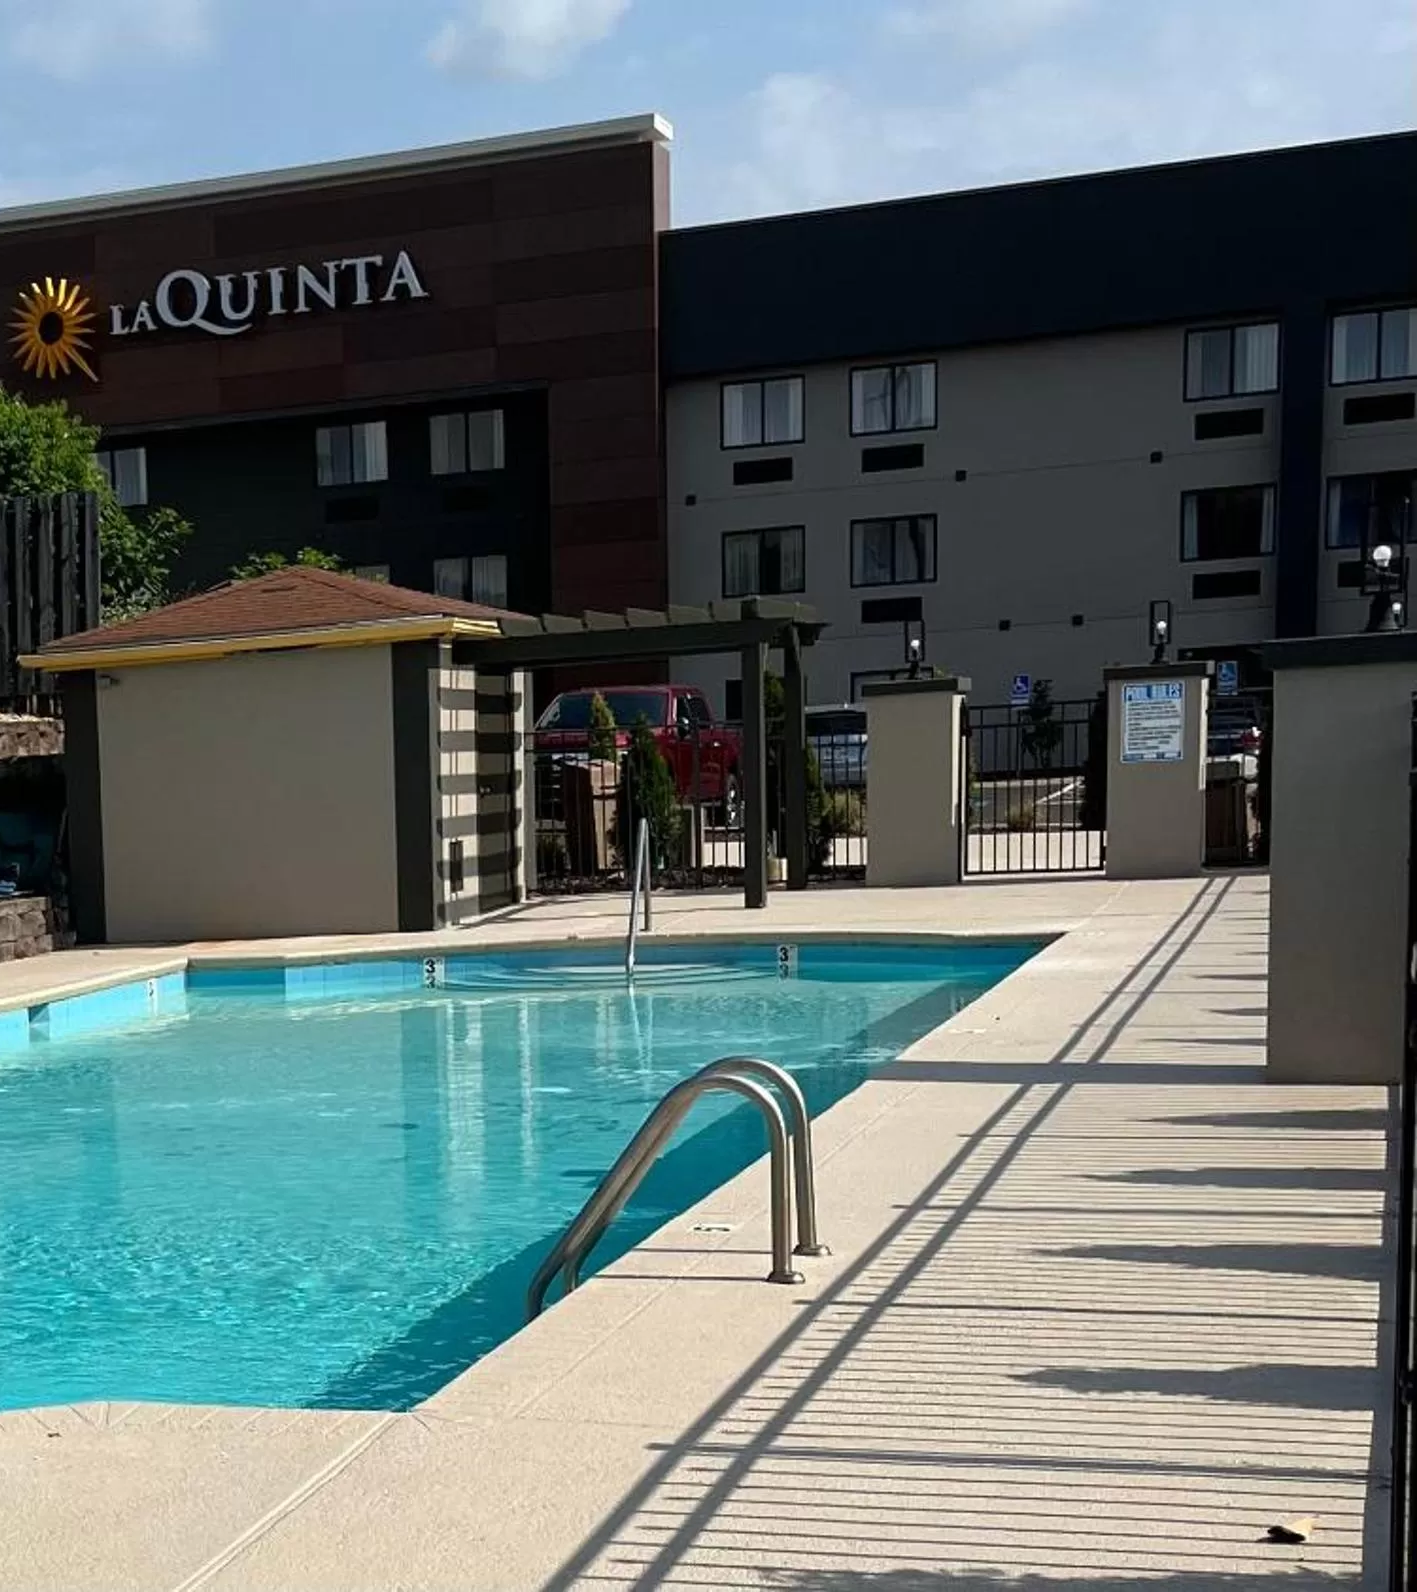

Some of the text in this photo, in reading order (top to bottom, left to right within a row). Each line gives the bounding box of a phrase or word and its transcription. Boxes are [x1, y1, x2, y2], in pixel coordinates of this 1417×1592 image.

[109, 251, 429, 335] LA QUINTA
[779, 946, 789, 962] 3
[425, 959, 436, 973] 3
